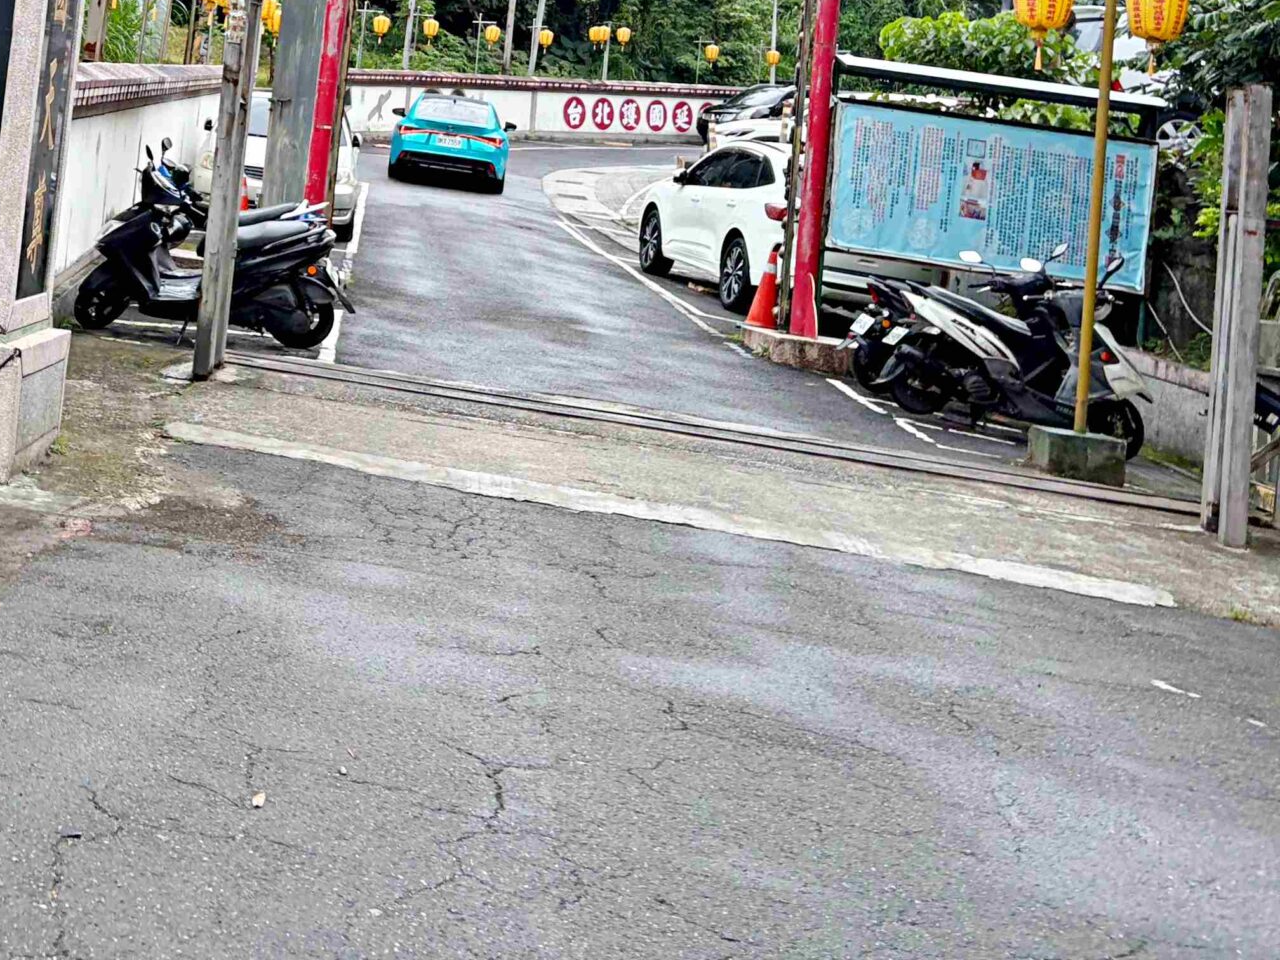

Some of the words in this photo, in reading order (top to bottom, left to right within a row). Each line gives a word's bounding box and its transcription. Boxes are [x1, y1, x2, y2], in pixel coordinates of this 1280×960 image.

[567, 99, 710, 129] 台北護國延
